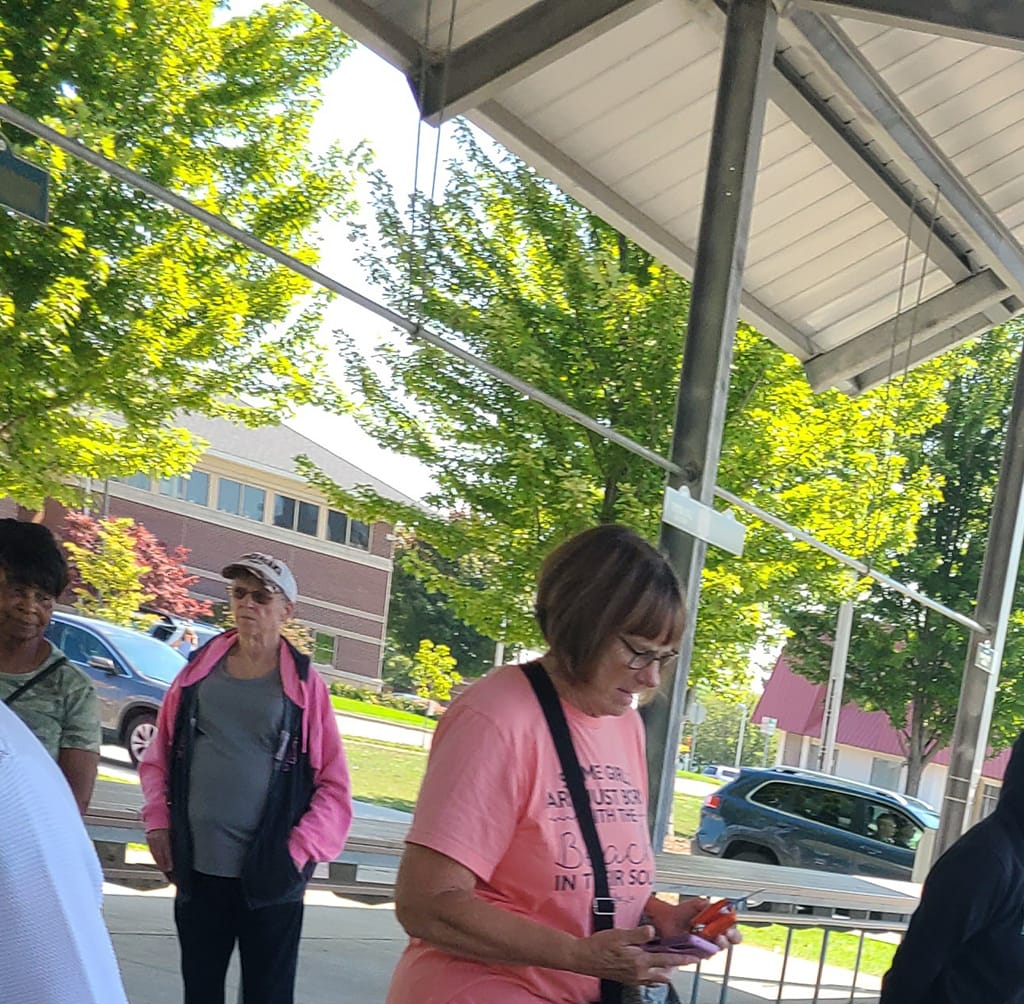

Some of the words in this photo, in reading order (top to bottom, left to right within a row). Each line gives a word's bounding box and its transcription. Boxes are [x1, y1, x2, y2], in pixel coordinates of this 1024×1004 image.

[547, 790, 573, 808] AR
[593, 788, 618, 805] UST
[620, 788, 642, 805] BOR
[554, 874, 577, 892] IN
[628, 868, 652, 886] SO
